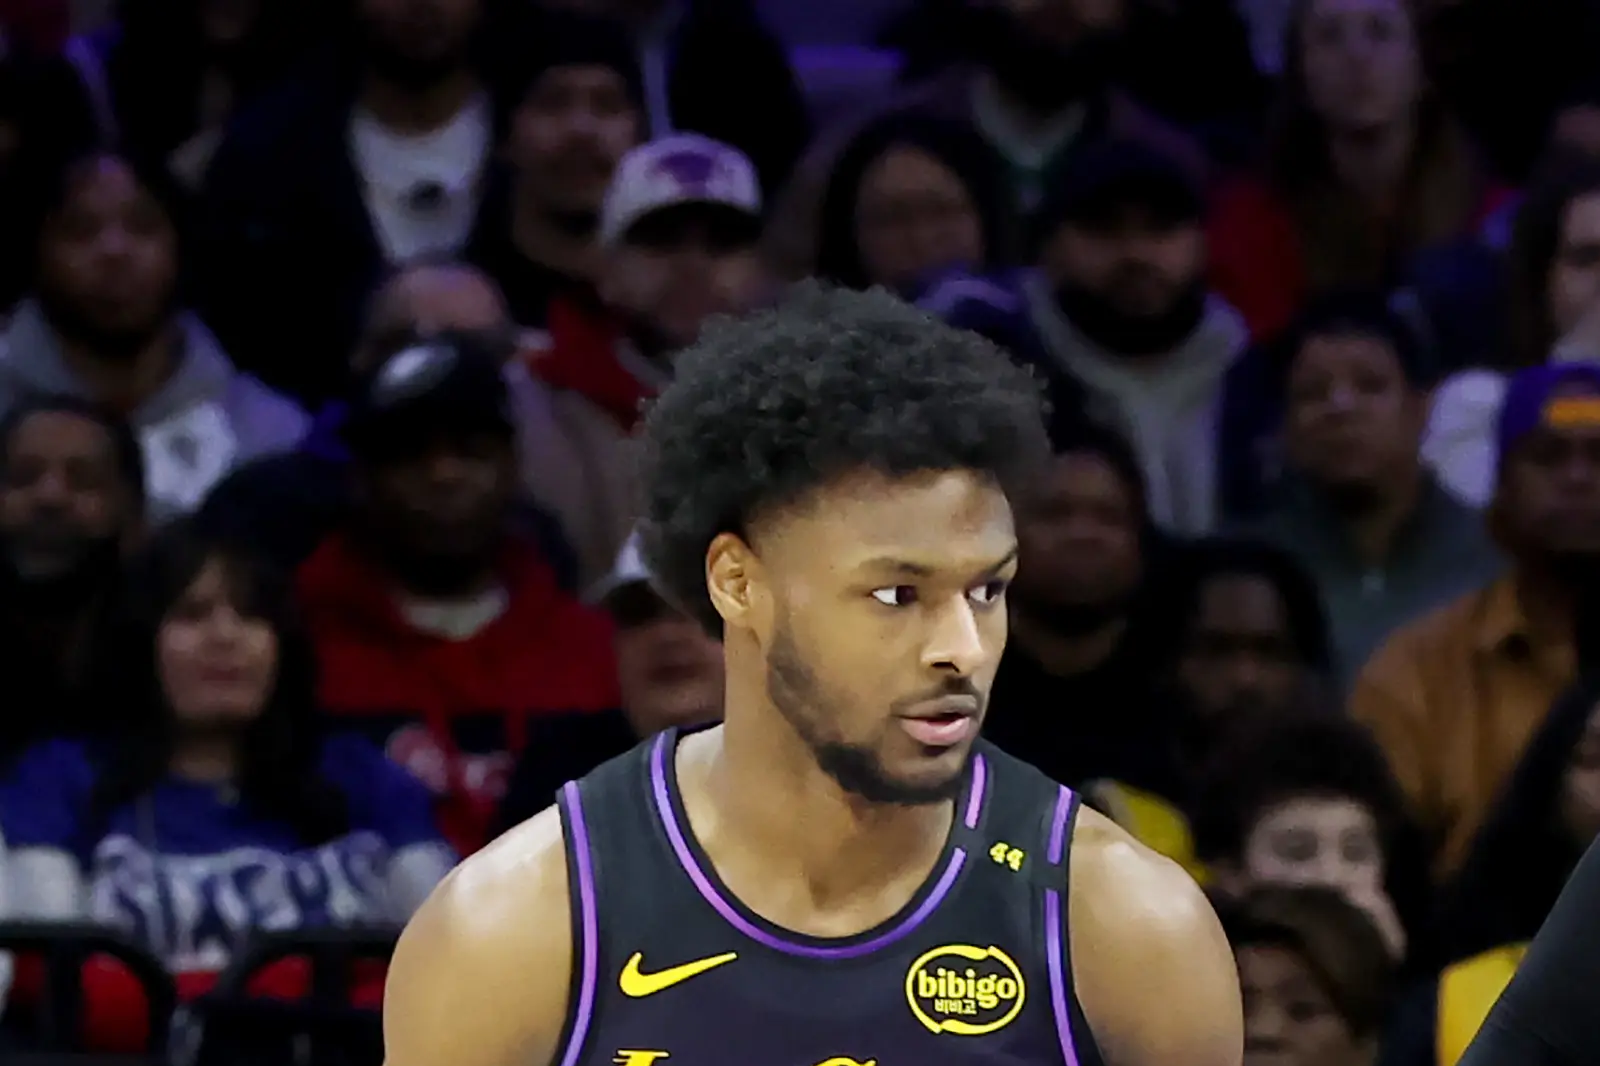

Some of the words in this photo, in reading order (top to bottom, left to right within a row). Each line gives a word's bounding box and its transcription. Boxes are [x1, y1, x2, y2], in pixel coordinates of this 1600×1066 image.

[989, 842, 1024, 872] 44
[917, 967, 1017, 1009] bibigo
[933, 998, 977, 1015] 비비고
